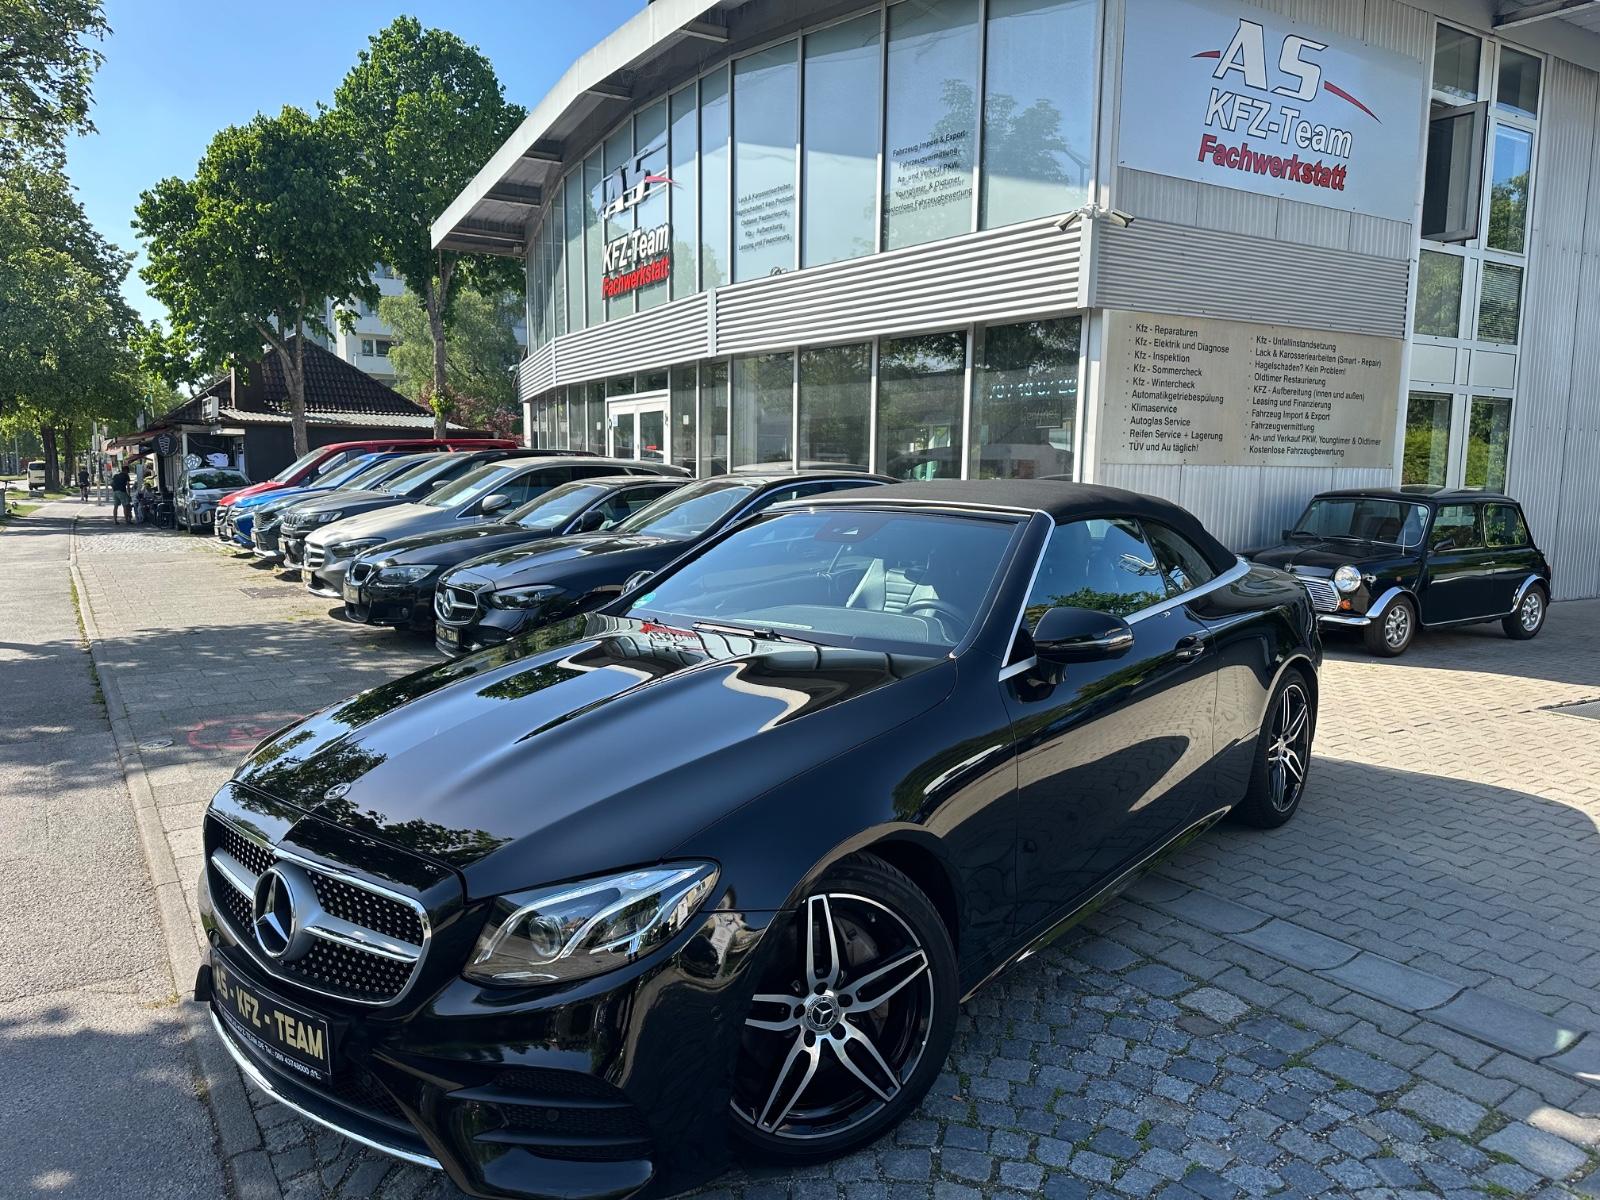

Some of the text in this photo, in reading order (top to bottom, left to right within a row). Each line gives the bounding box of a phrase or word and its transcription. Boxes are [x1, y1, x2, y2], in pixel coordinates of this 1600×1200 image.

[1212, 18, 1328, 102] AS
[1205, 87, 1352, 158] KFZ-Team
[946, 130, 965, 141] Export
[1198, 134, 1346, 191] Fachwerkstatt
[602, 224, 670, 274] KFZ-Team
[602, 255, 670, 300] Fachwerkstatt
[1136, 324, 1148, 333] Kfz
[1154, 325, 1198, 337] Reparaturen
[1135, 337, 1147, 346] Kfz
[1154, 339, 1180, 348] Elektrik
[1198, 343, 1229, 353] Diagnose
[1256, 336, 1267, 344] Kfz
[1273, 337, 1336, 352] Unfallinstandsetzung
[1134, 351, 1146, 359] Kfz
[1153, 352, 1190, 363] Inspektion
[1256, 348, 1270, 356] Lack
[1280, 350, 1336, 362] Karosseriearbeiten
[1338, 356, 1356, 365] (Smart
[1362, 358, 1381, 368] Repair)
[1134, 364, 1146, 372] Kfz
[1152, 365, 1202, 376] Sommercheck
[1255, 361, 1345, 375] Hagelschaden? Kein Problem!
[1133, 377, 1144, 386] Kfz
[1152, 378, 1195, 389] Wintercheck
[1254, 373, 1326, 387] Oldtimer Restaurierung
[1132, 390, 1224, 404] Automatikgetriebespülung
[1254, 385, 1267, 393] KFZ
[1272, 386, 1312, 398] Aufbereitung
[1314, 389, 1331, 400] (innen
[1346, 392, 1364, 402] außen)
[1132, 403, 1177, 413] Klimaservice
[1253, 397, 1277, 407] Leasing
[1293, 399, 1331, 410] Finanzierung
[1130, 416, 1191, 427] Autoglas Service
[1252, 409, 1281, 419] Fahrzeug
[1283, 411, 1303, 420] Import
[1311, 412, 1330, 421] Export
[1251, 421, 1314, 432] Fahrzeugvermittlung
[1130, 429, 1153, 438] Reifen
[1155, 430, 1181, 438] Service
[1191, 431, 1223, 442] Lagerung
[1277, 434, 1300, 442] Verkauf
[1319, 436, 1350, 445] Youngtimer
[1358, 437, 1381, 445] Oldtimer
[1129, 440, 1144, 450] TÜV
[1162, 443, 1171, 451] Au
[1173, 444, 1198, 453] täglich!
[1249, 446, 1344, 457] Kostenlose Fahrzeugbewertung
[236, 986, 261, 1028] KFZ
[274, 1010, 323, 1060] TEAM
